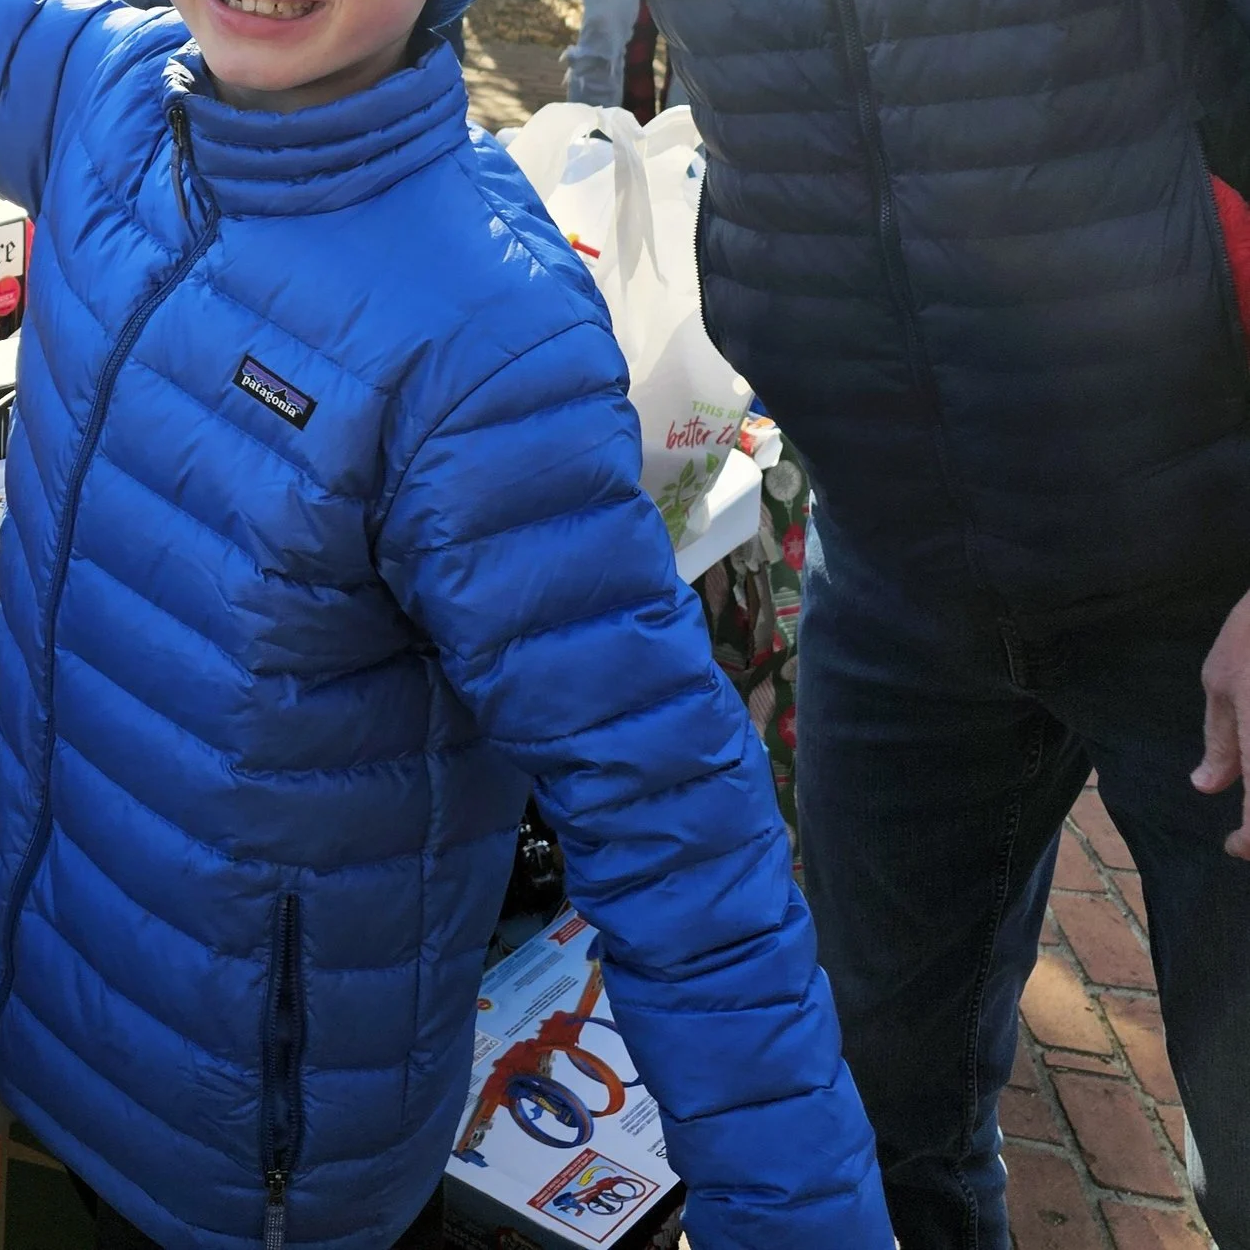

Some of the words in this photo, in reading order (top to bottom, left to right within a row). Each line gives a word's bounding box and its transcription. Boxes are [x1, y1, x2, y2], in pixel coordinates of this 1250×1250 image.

[241, 375, 298, 418] patagonia
[692, 400, 723, 418] THIS
[666, 415, 713, 449] better
